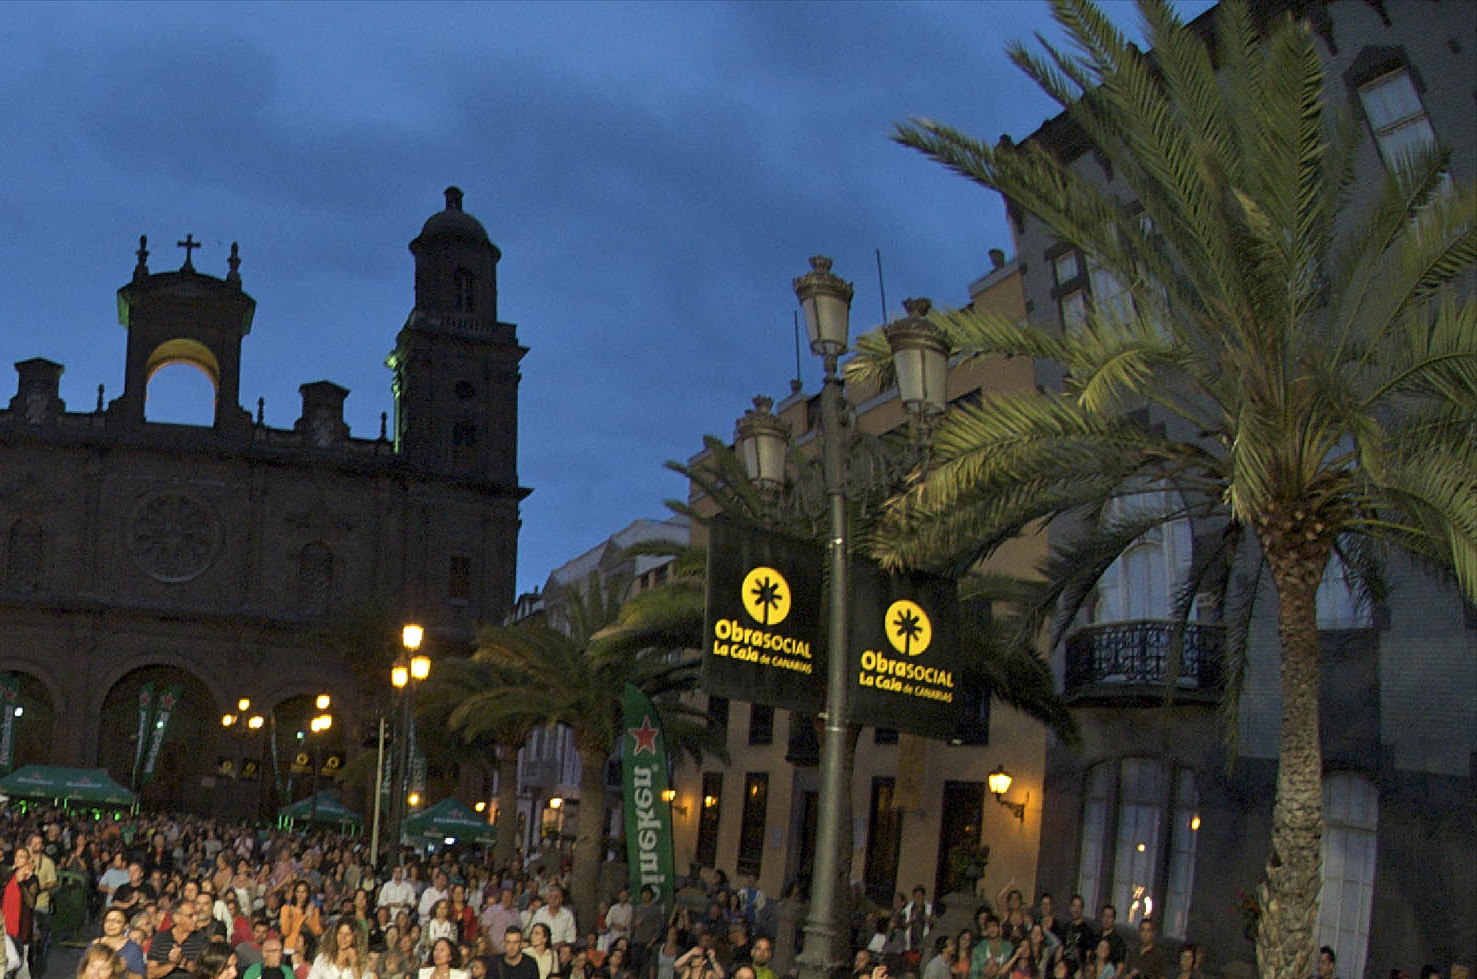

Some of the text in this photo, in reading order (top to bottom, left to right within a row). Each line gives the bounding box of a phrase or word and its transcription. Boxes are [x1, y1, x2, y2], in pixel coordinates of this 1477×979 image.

[713, 640, 729, 656] La
[730, 643, 759, 662] Caja
[859, 671, 874, 687] La
[875, 675, 903, 693] Caja
